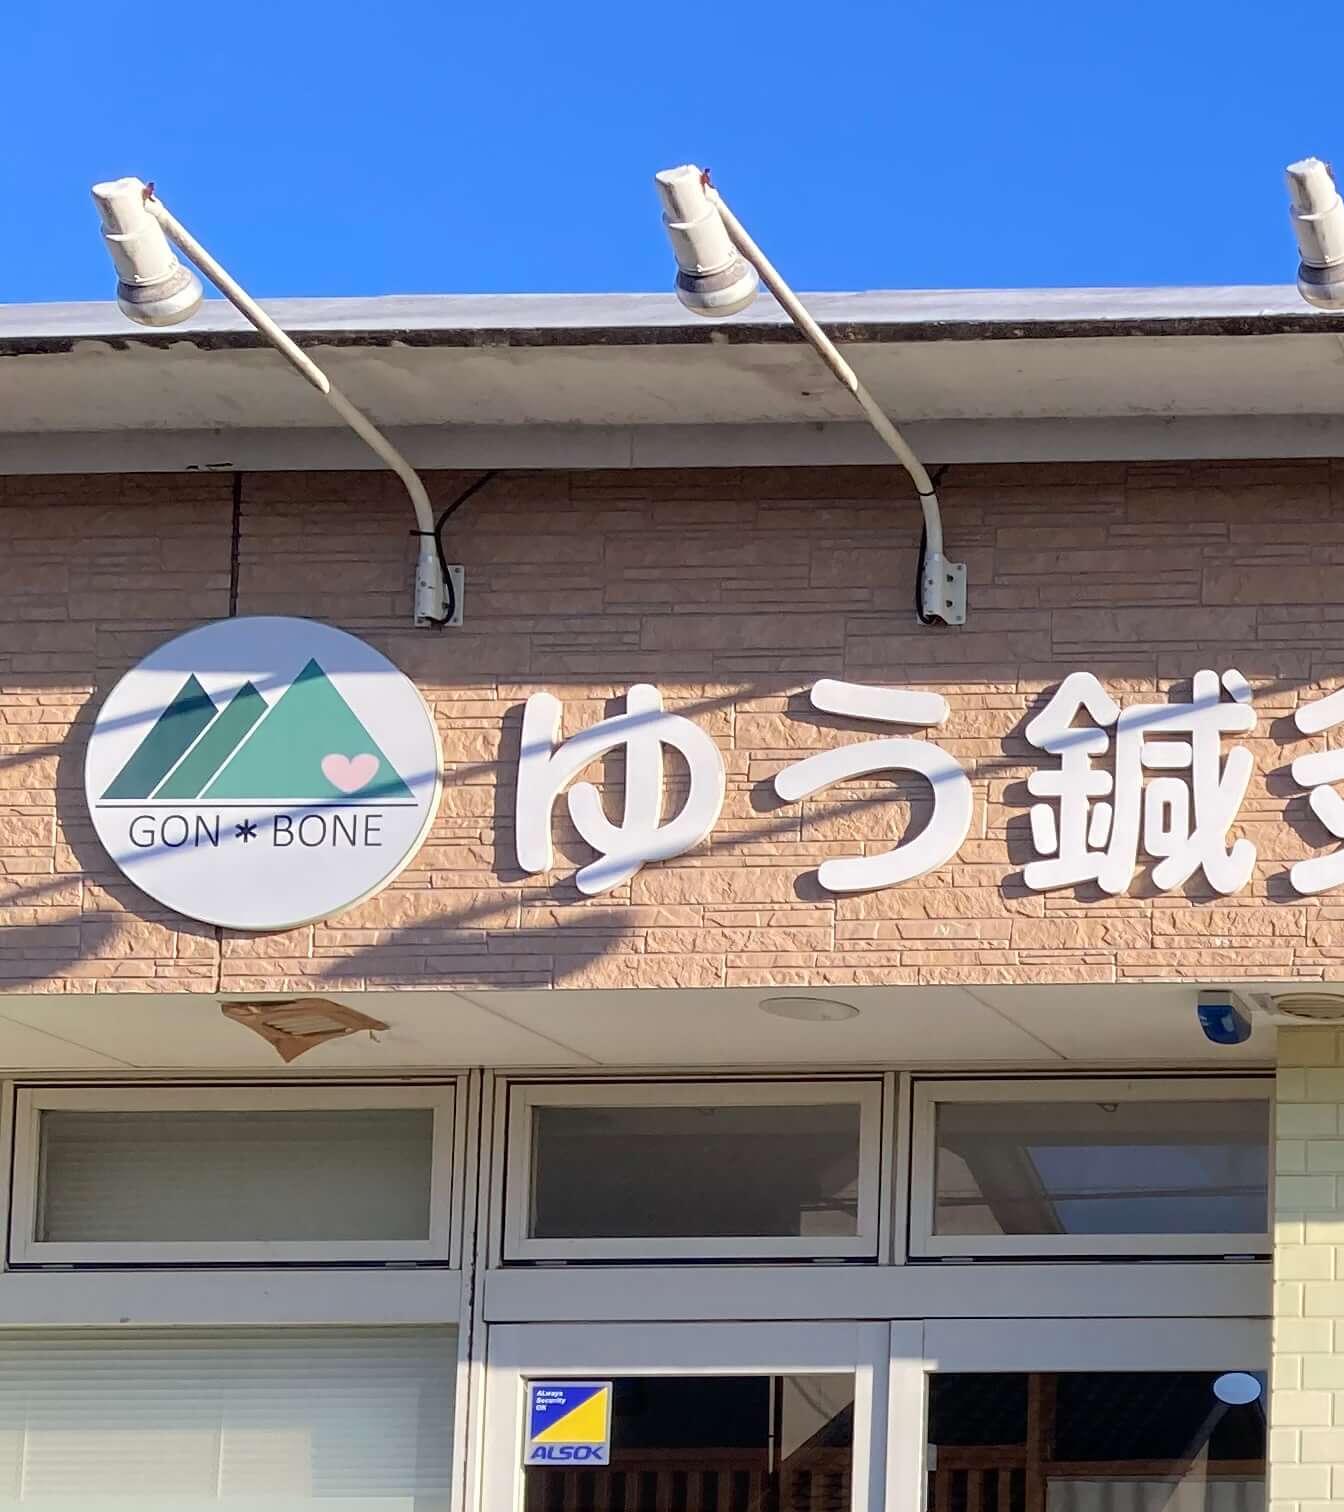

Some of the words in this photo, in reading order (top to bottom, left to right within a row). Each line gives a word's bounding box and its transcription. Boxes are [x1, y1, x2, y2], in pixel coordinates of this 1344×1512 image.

[128, 813, 221, 849] GON
[271, 813, 383, 848] BONE
[530, 1445, 604, 1460] ALSOK
